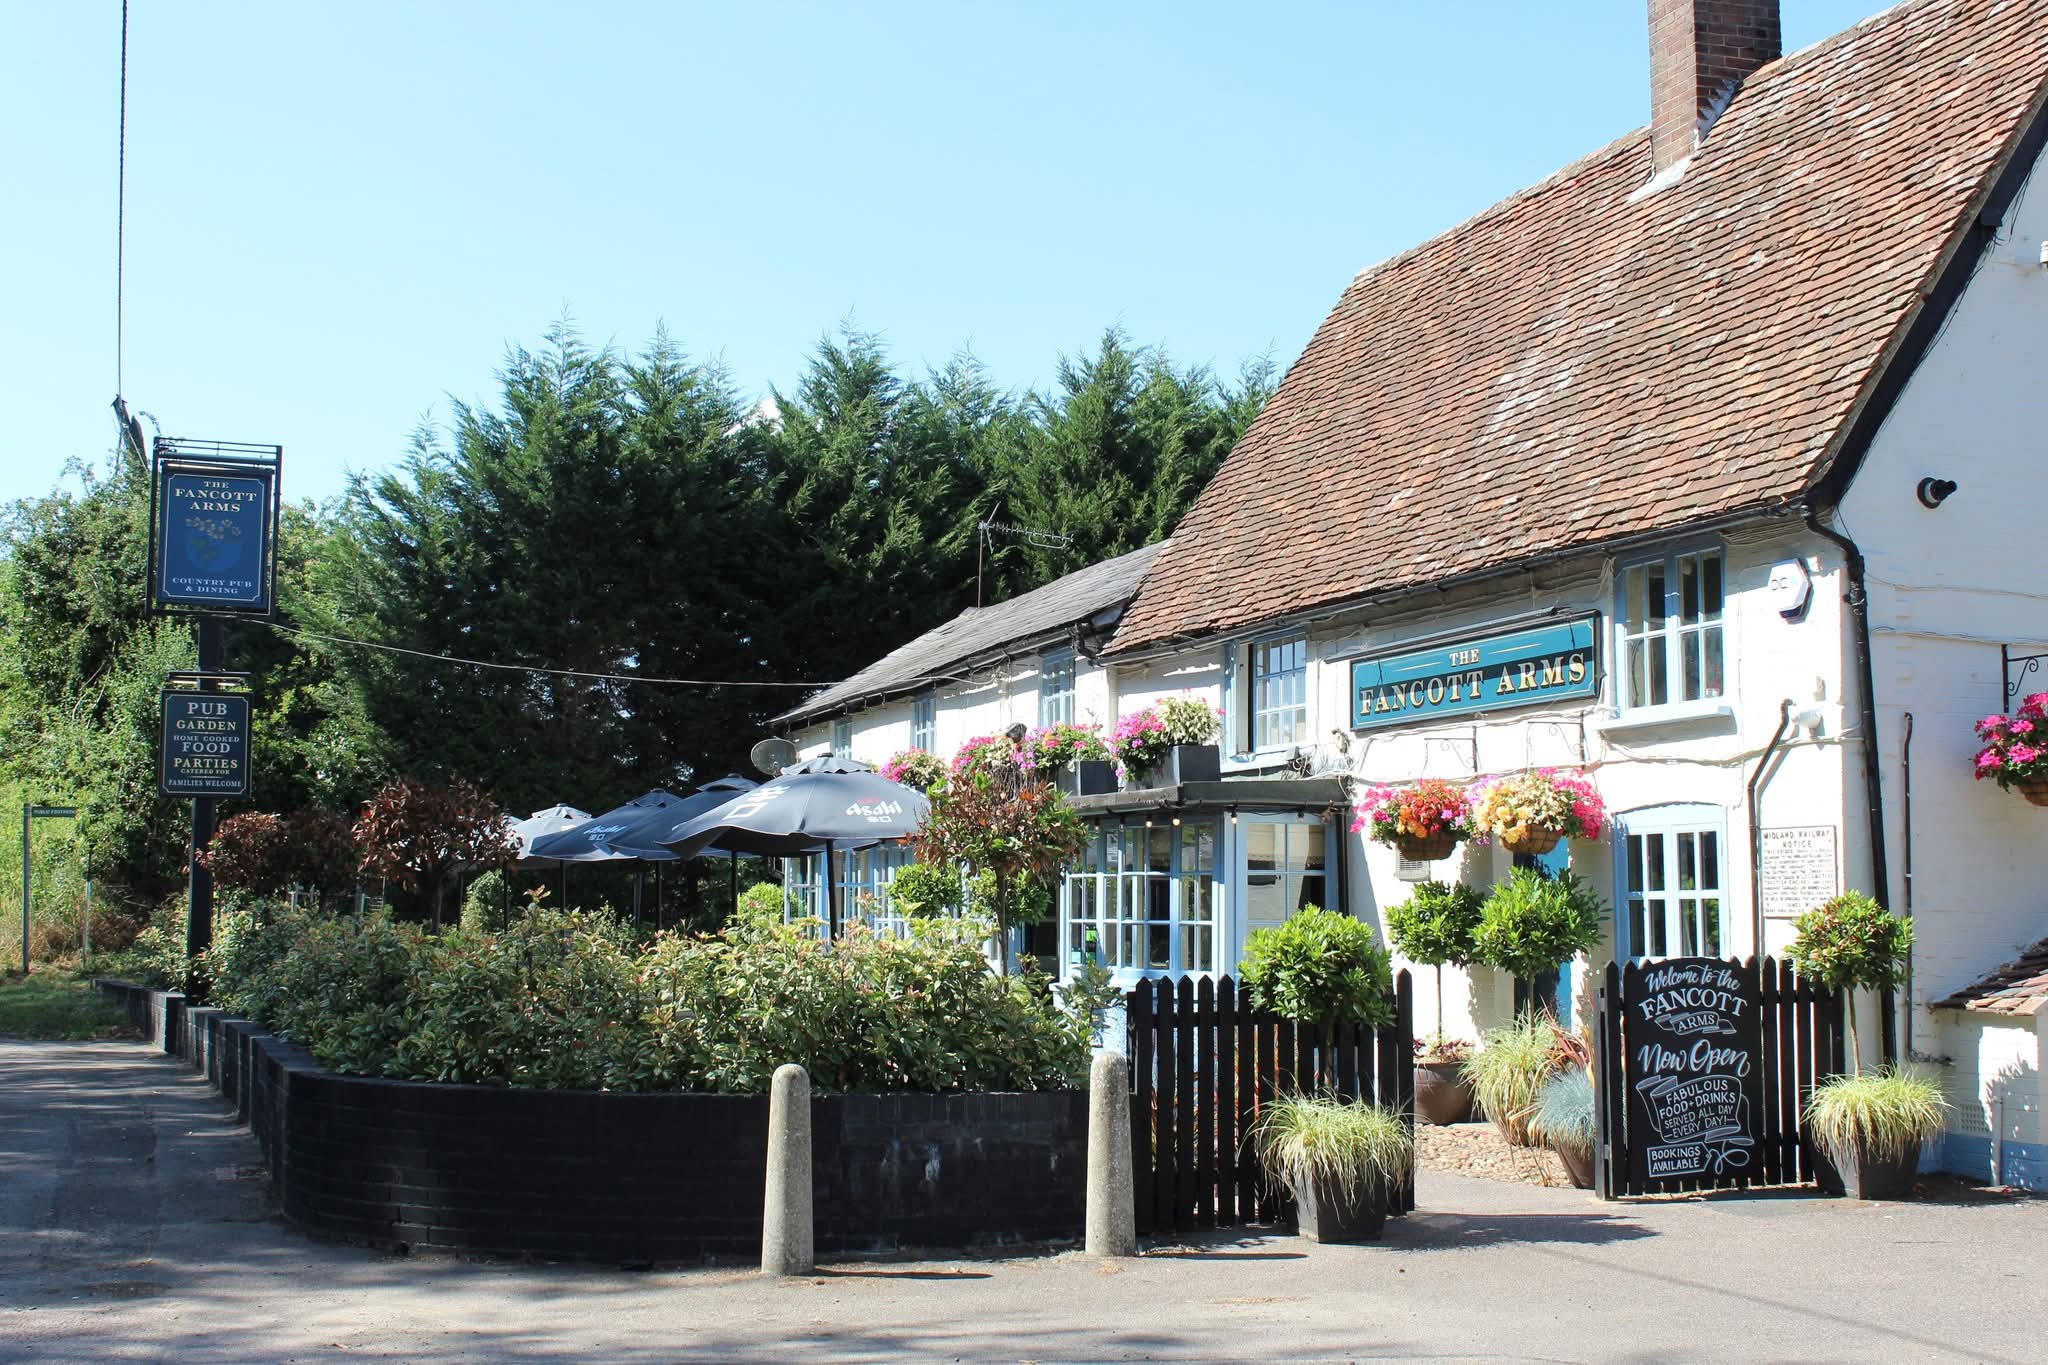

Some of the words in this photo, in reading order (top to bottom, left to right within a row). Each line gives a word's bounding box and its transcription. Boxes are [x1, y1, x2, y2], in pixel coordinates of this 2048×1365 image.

[175, 488, 257, 502] FANCOTT
[190, 501, 241, 512] ARMS
[172, 577, 225, 586] COUNTRY
[198, 586, 239, 594] DINING
[1449, 648, 1479, 667] THE
[1359, 670, 1484, 715] FANCOTT
[1496, 652, 1585, 696] ARMS
[186, 702, 228, 715] PUB
[176, 720, 237, 731] GARDEN
[182, 742, 231, 753] FOOD
[173, 758, 238, 769] PARTIES
[168, 779, 203, 787] FAMILIES
[845, 799, 903, 816] Asahi
[1763, 831, 1794, 840] MIDLAND
[1799, 830, 1831, 838] RAILWAY
[1782, 840, 1812, 848] NOTICE
[1645, 966, 1699, 993] Welcome
[1713, 969, 1741, 991] the
[1638, 987, 1748, 1021] FANCOTT
[1677, 1014, 1715, 1032] ARMS
[1637, 1043, 1687, 1073] Now
[1690, 1039, 1751, 1077] Open
[1665, 1080, 1729, 1105] FABULOUS
[1659, 1100, 1689, 1119] FOOD
[1695, 1091, 1736, 1107] DRINKS
[1664, 1111, 1696, 1129] SERVED
[1699, 1105, 1715, 1119] ALL
[1718, 1104, 1734, 1115] DAY
[1672, 1120, 1701, 1138] EVERY
[1704, 1115, 1727, 1129] DAY!
[1651, 1146, 1701, 1161] BOOKINGS
[1652, 1157, 1701, 1174] AVAILABLE
